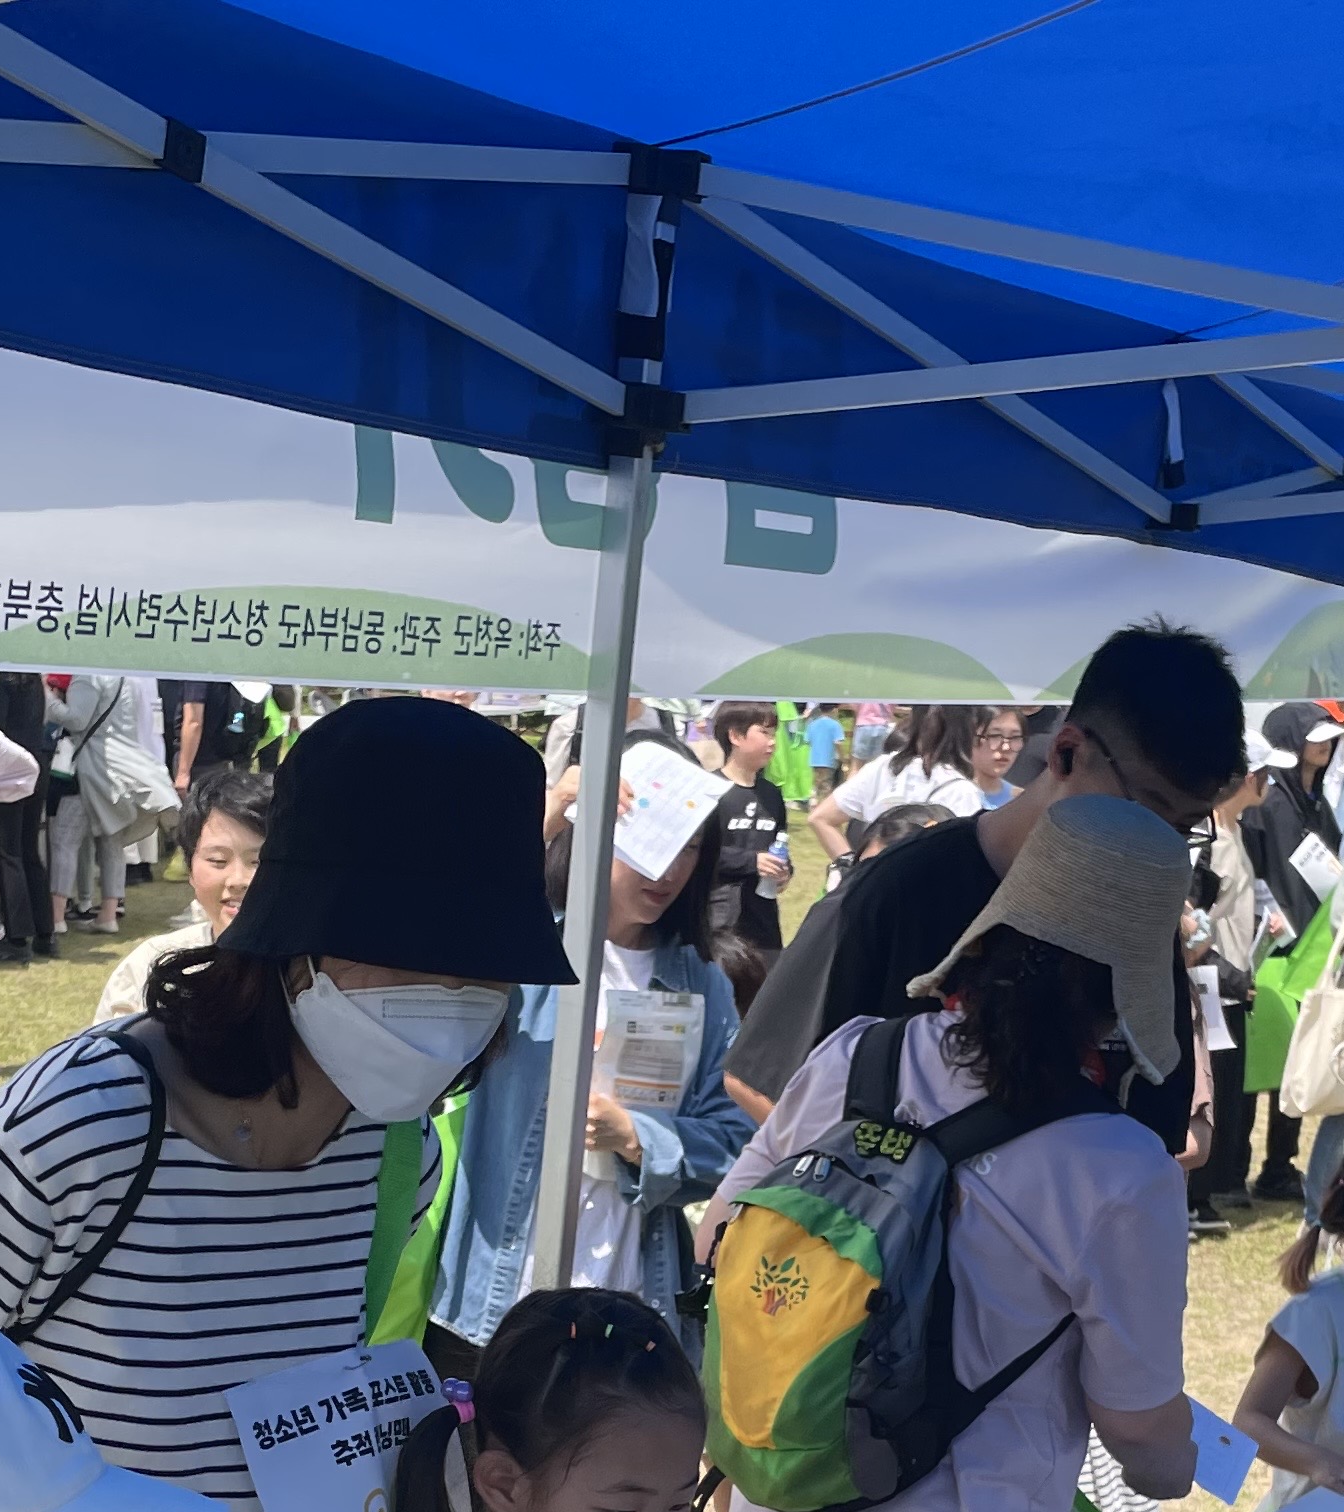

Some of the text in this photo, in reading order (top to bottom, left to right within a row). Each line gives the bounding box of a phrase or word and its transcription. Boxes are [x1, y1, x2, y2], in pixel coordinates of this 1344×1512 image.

[252, 1404, 321, 1451] 청소년
[317, 1386, 370, 1424] 가족
[368, 1374, 412, 1408] 포스트
[330, 1429, 376, 1467] 추적
